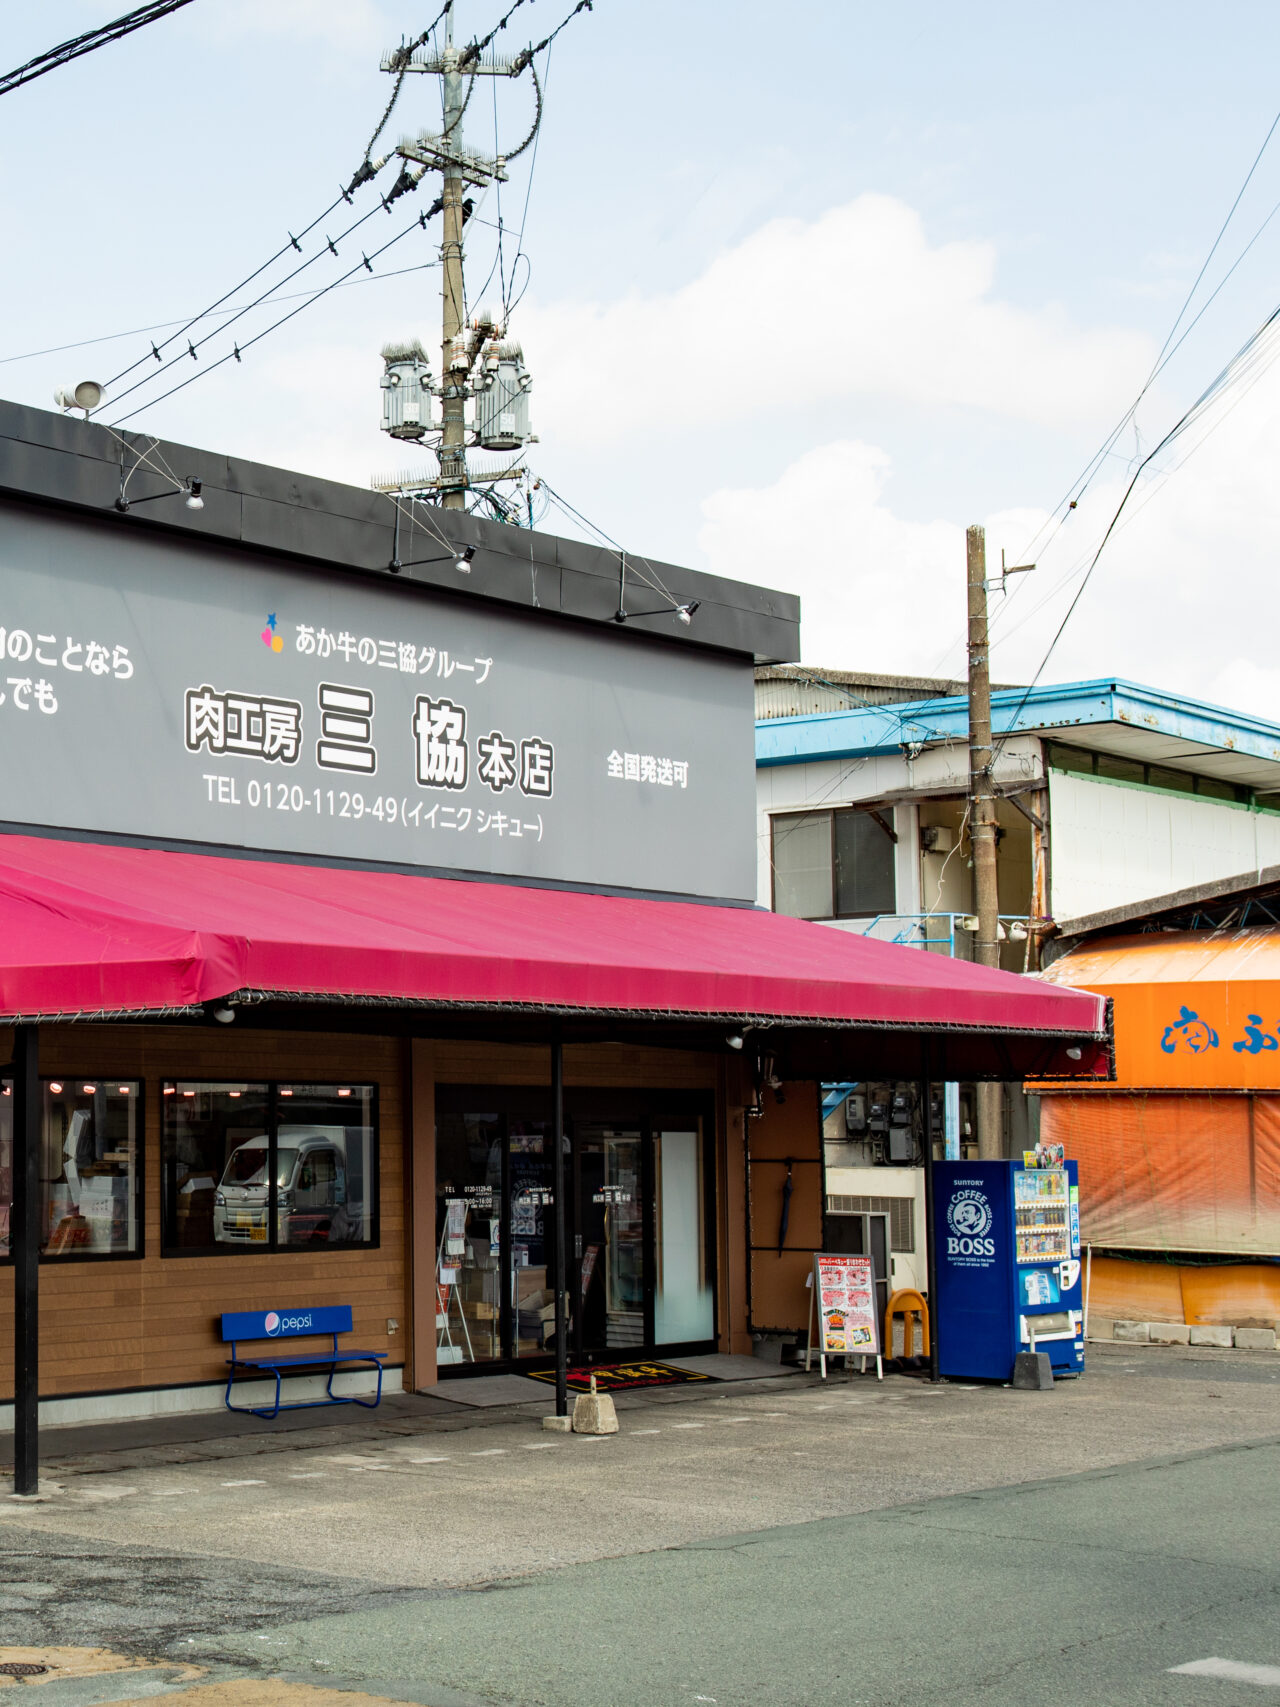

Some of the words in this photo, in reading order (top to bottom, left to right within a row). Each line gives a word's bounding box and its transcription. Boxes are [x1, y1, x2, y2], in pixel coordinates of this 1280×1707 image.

[296, 624, 493, 685] あか牛の三協グループ
[185, 685, 303, 764] 肉工房
[316, 681, 468, 791] 三協
[477, 730, 555, 799] 本店
[607, 750, 689, 788] 全国発送可
[203, 774, 240, 805] TEL
[951, 1189, 988, 1204] COFFEE
[947, 1237, 995, 1256] BOSS
[282, 1313, 312, 1331] pepsi
